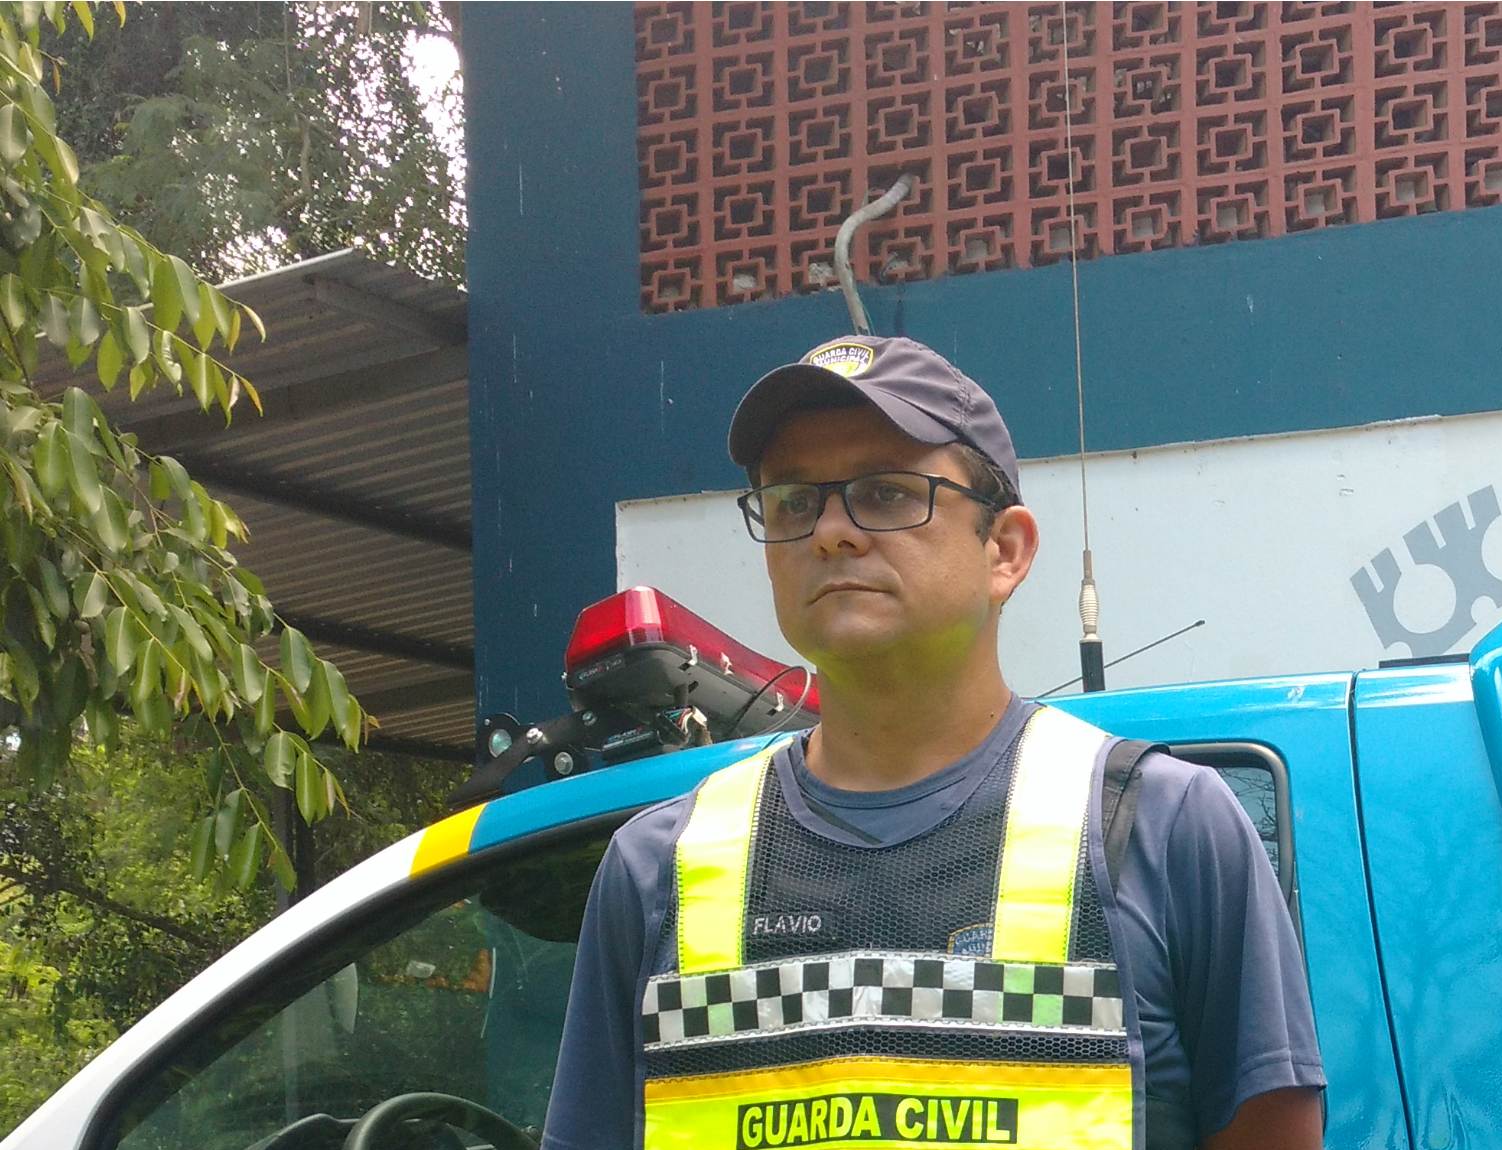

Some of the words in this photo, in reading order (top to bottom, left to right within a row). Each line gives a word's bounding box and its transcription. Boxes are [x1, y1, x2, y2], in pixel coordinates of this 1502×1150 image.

[752, 914, 822, 936] FLAVIO
[741, 1097, 882, 1148] GUARDA
[895, 1097, 1012, 1143] CIVIL
